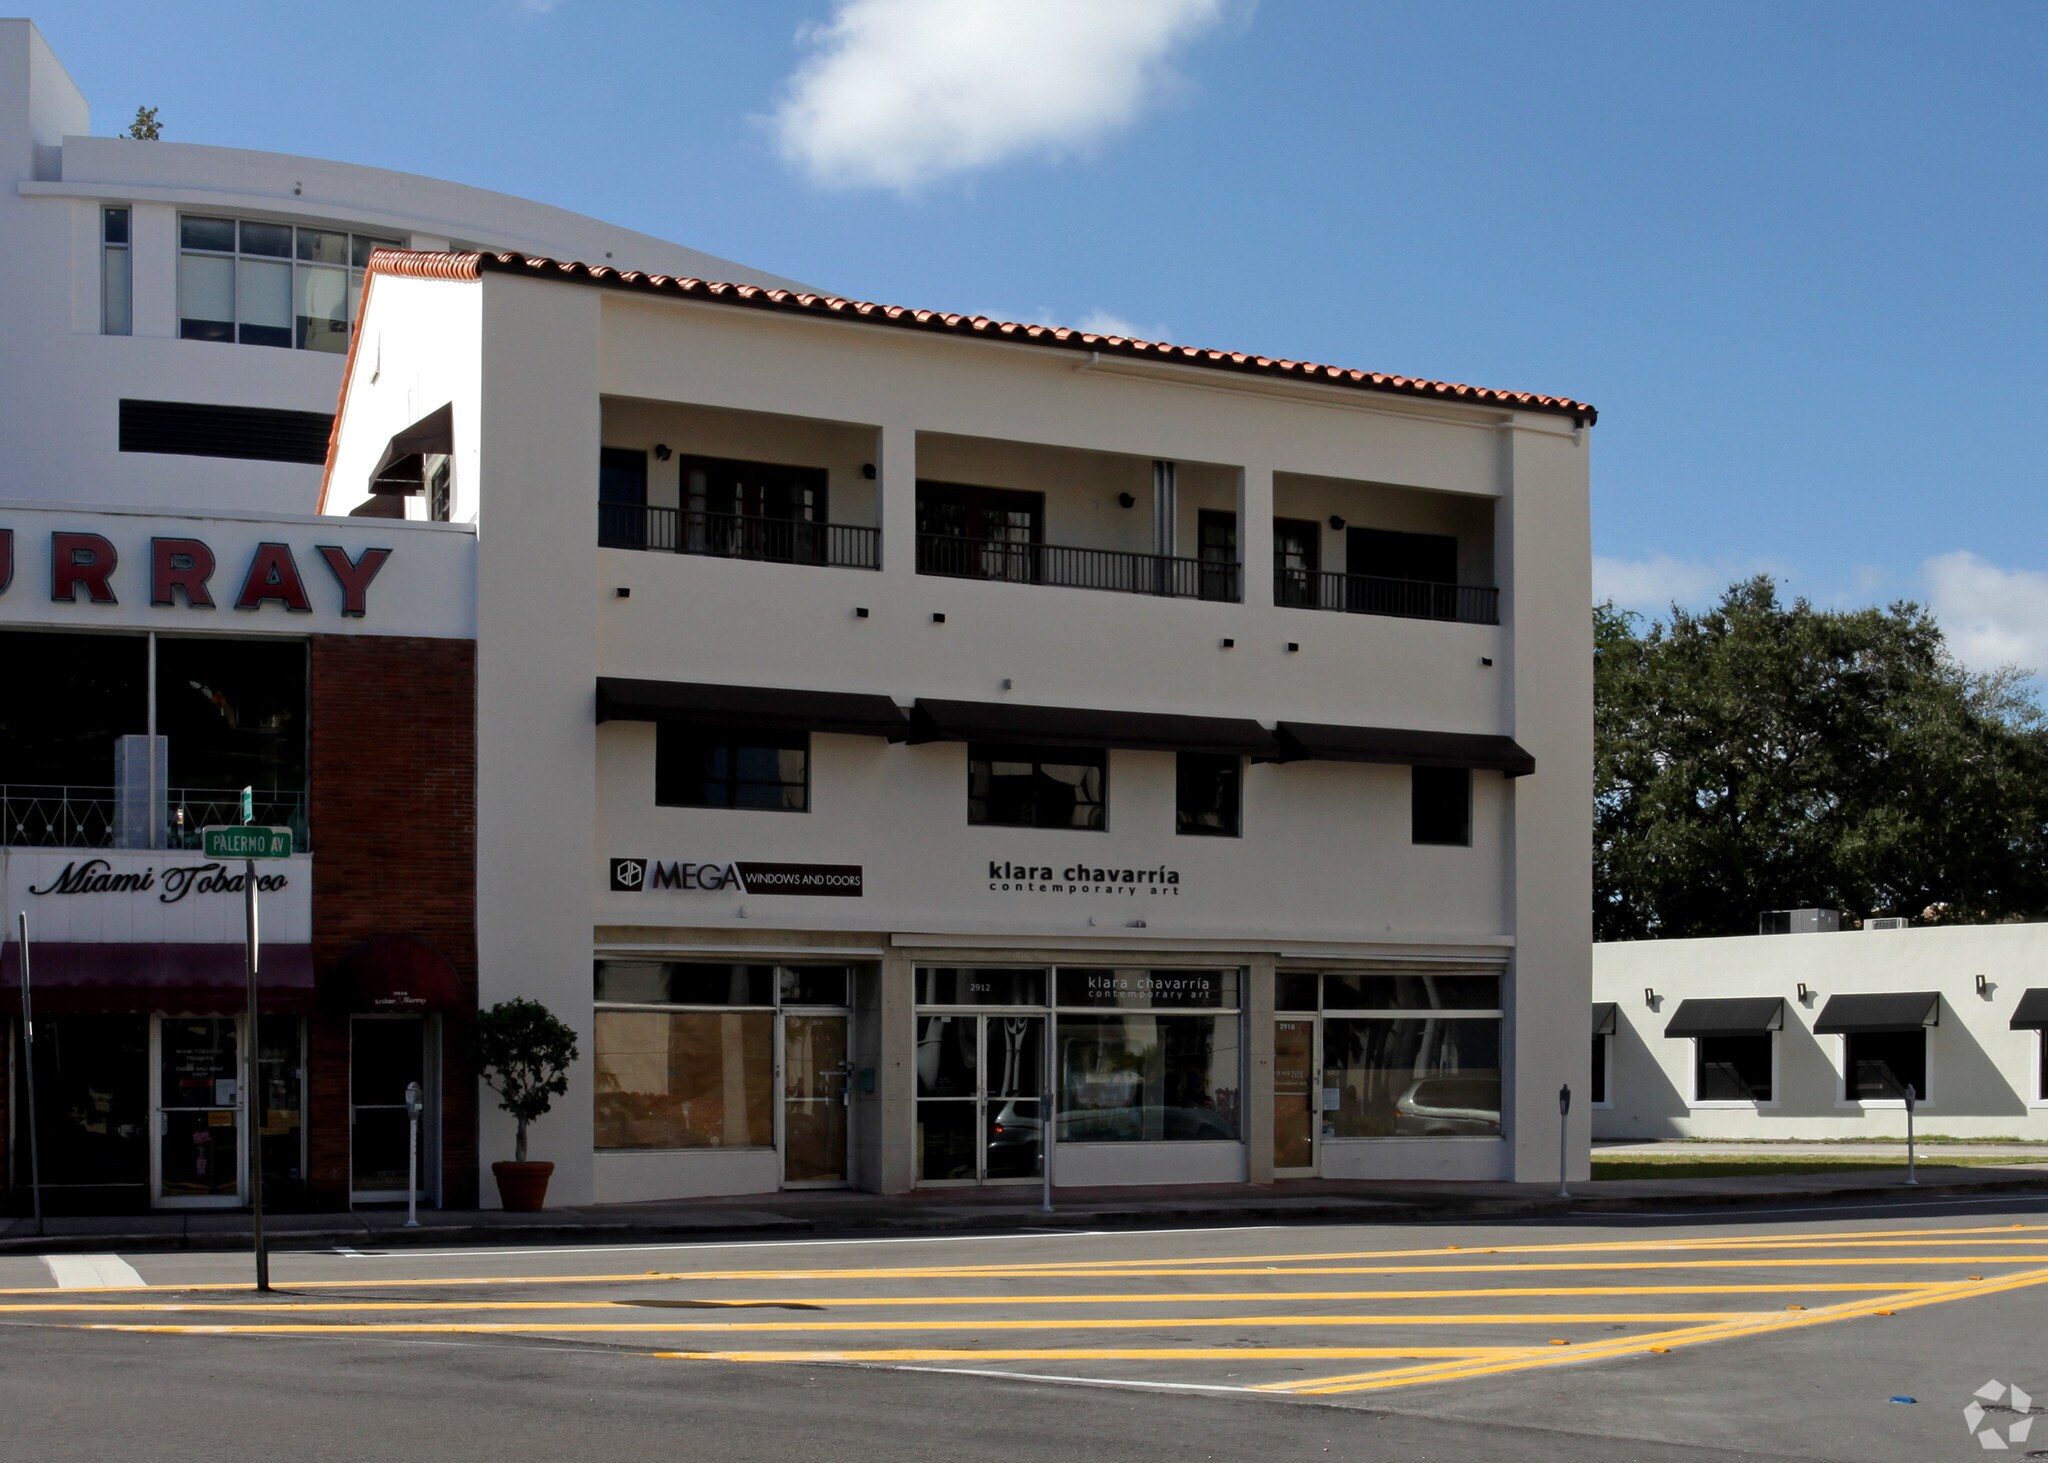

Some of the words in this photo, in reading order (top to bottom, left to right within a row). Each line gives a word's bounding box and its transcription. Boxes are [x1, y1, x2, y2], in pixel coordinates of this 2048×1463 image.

[0, 529, 393, 617] RRAY
[213, 835, 265, 852] PALERMO
[271, 838, 284, 853] AV
[29, 859, 155, 895] Miami
[160, 863, 288, 903] Tobaco
[652, 860, 741, 891] MEGA
[746, 873, 800, 885] WINDOWS
[802, 874, 824, 885] AND
[826, 875, 861, 886] DOORS
[989, 861, 1053, 881] klara
[1063, 864, 1180, 884] chavarría
[989, 881, 1136, 896] contemporary
[1150, 886, 1179, 896] art
[970, 983, 991, 992] 2912
[1088, 976, 1128, 989] klara
[1137, 977, 1209, 990] chavarría
[1088, 990, 1183, 999] contemporary
[1191, 991, 1210, 999] art
